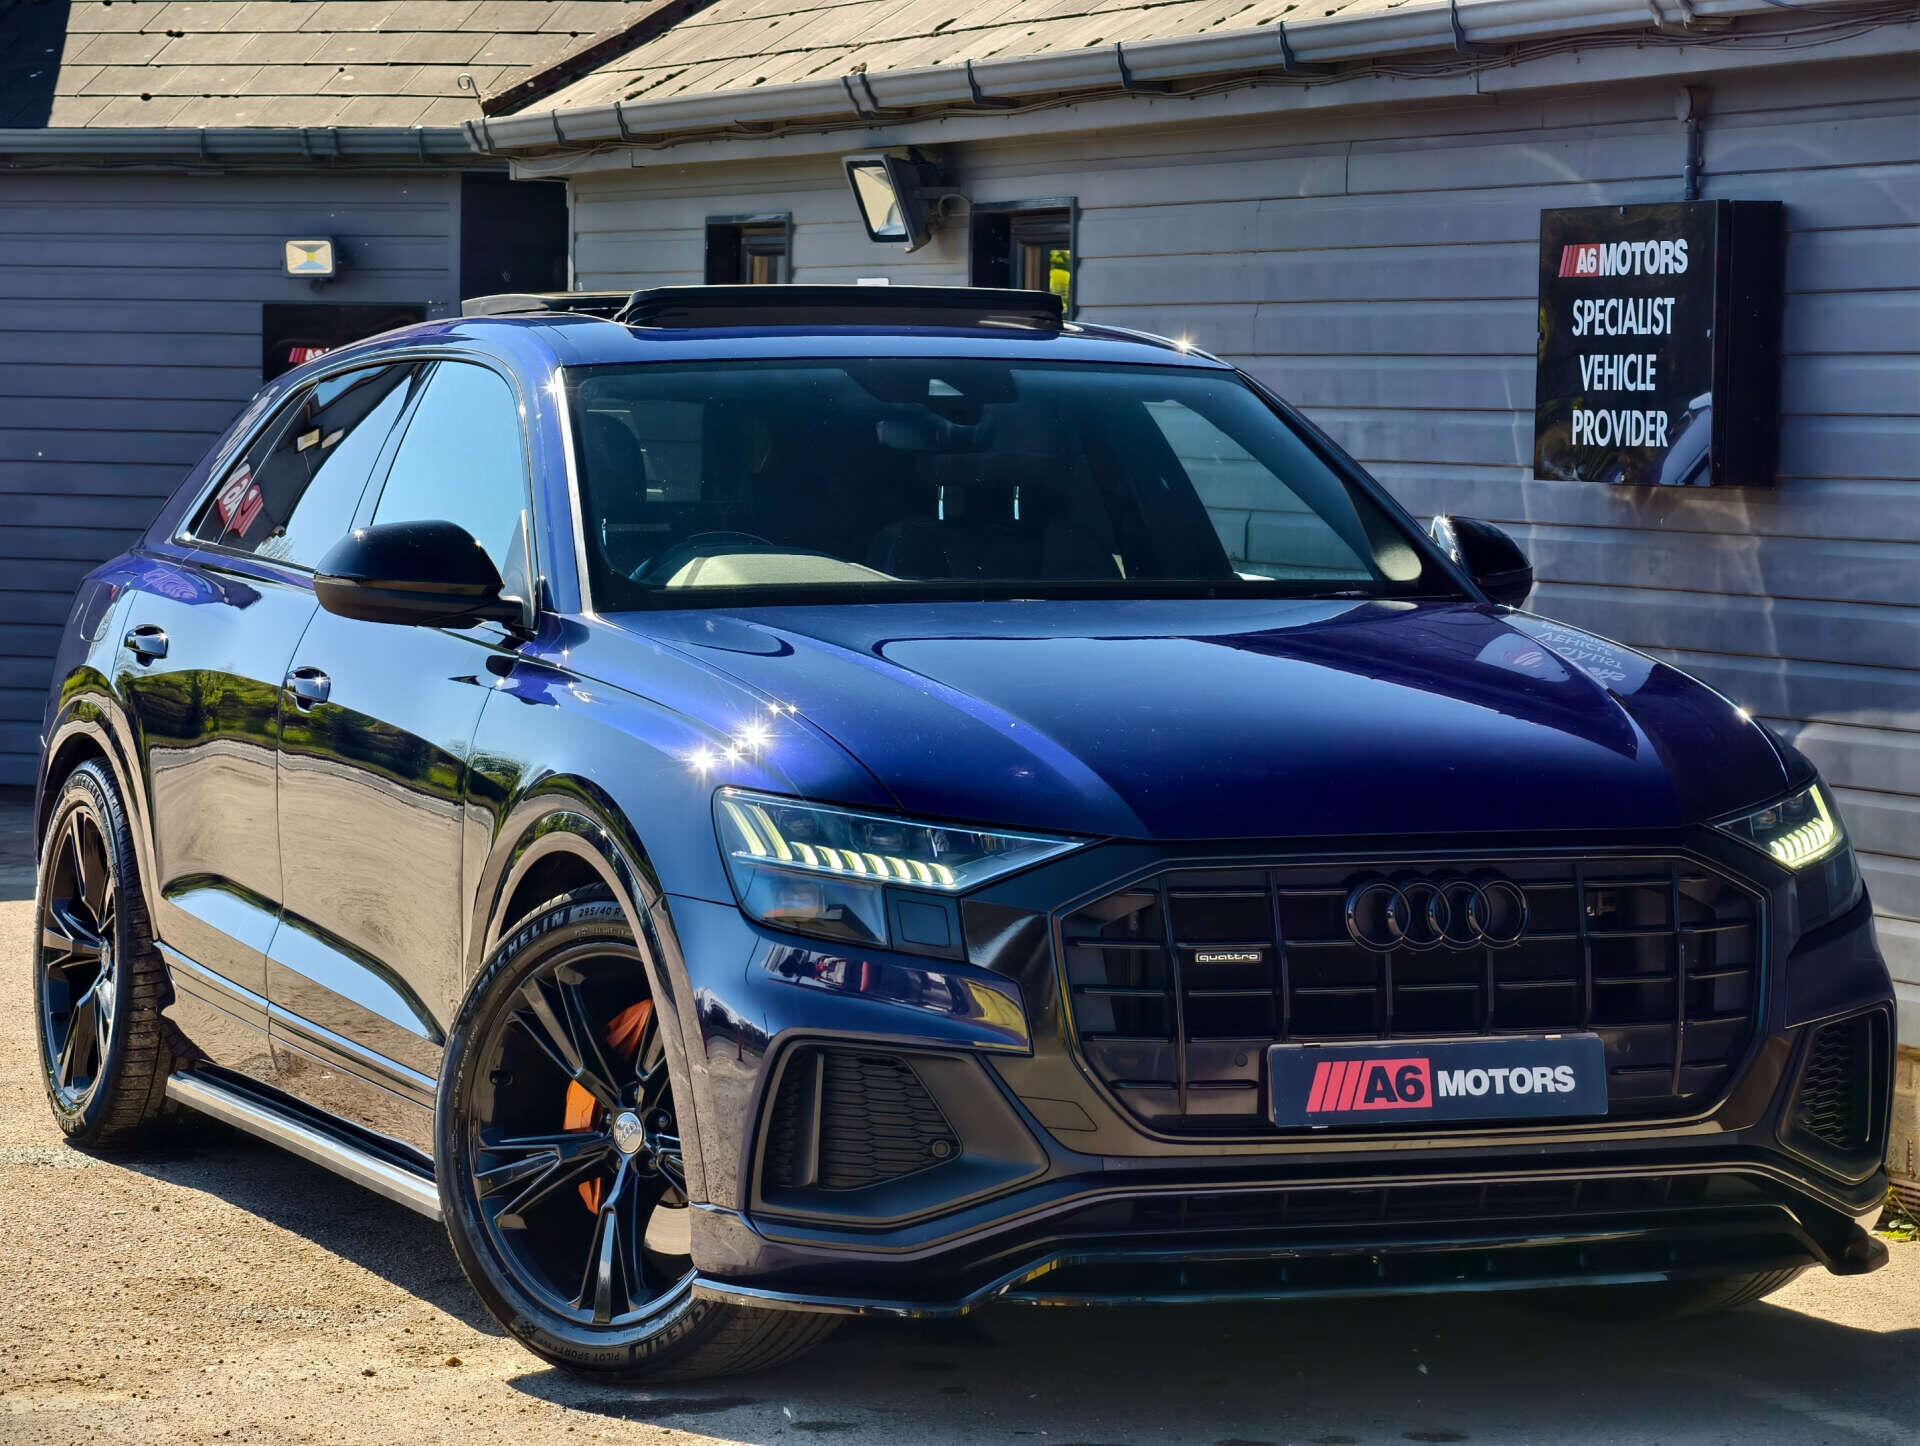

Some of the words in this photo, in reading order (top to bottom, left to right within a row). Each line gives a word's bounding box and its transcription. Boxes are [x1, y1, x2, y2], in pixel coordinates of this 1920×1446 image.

[1575, 247, 1597, 274] A6
[1599, 238, 1688, 276] MOTORS
[1571, 297, 1675, 337] SPECIALIST
[1579, 353, 1657, 392] VEHICLE
[1571, 409, 1668, 448] PROVIDER
[1199, 953, 1258, 963] quattro
[1363, 1064, 1425, 1104] A6
[1438, 1065, 1576, 1097] MOTORS
[592, 1352, 621, 1362] PILOT
